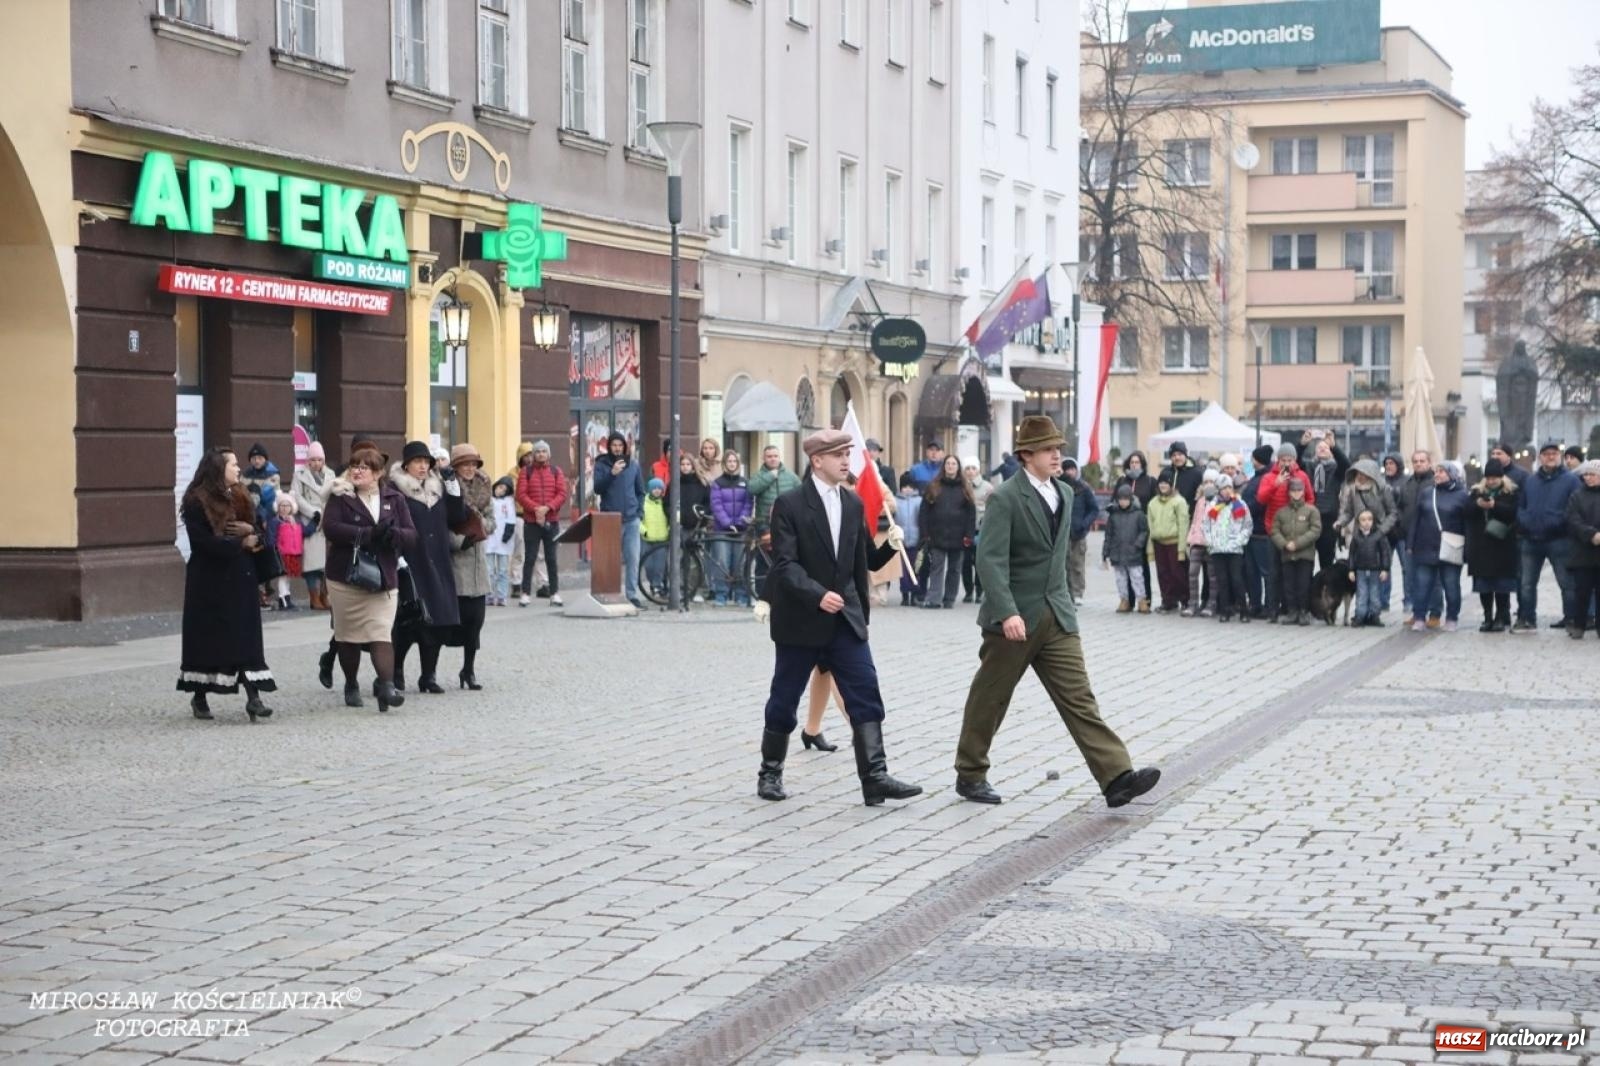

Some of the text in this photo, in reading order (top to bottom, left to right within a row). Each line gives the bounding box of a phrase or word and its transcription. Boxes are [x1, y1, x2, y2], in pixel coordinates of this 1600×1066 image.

[1189, 24, 1315, 48] McDonald's
[1167, 53, 1182, 63] m
[130, 151, 409, 262] APTEKA
[327, 260, 406, 285] POD RÓŻAMI
[174, 271, 217, 292] RYNEK
[220, 277, 234, 294] 12
[242, 279, 296, 301] CENTRUM
[298, 286, 389, 311] FARMACEUTYCZNE
